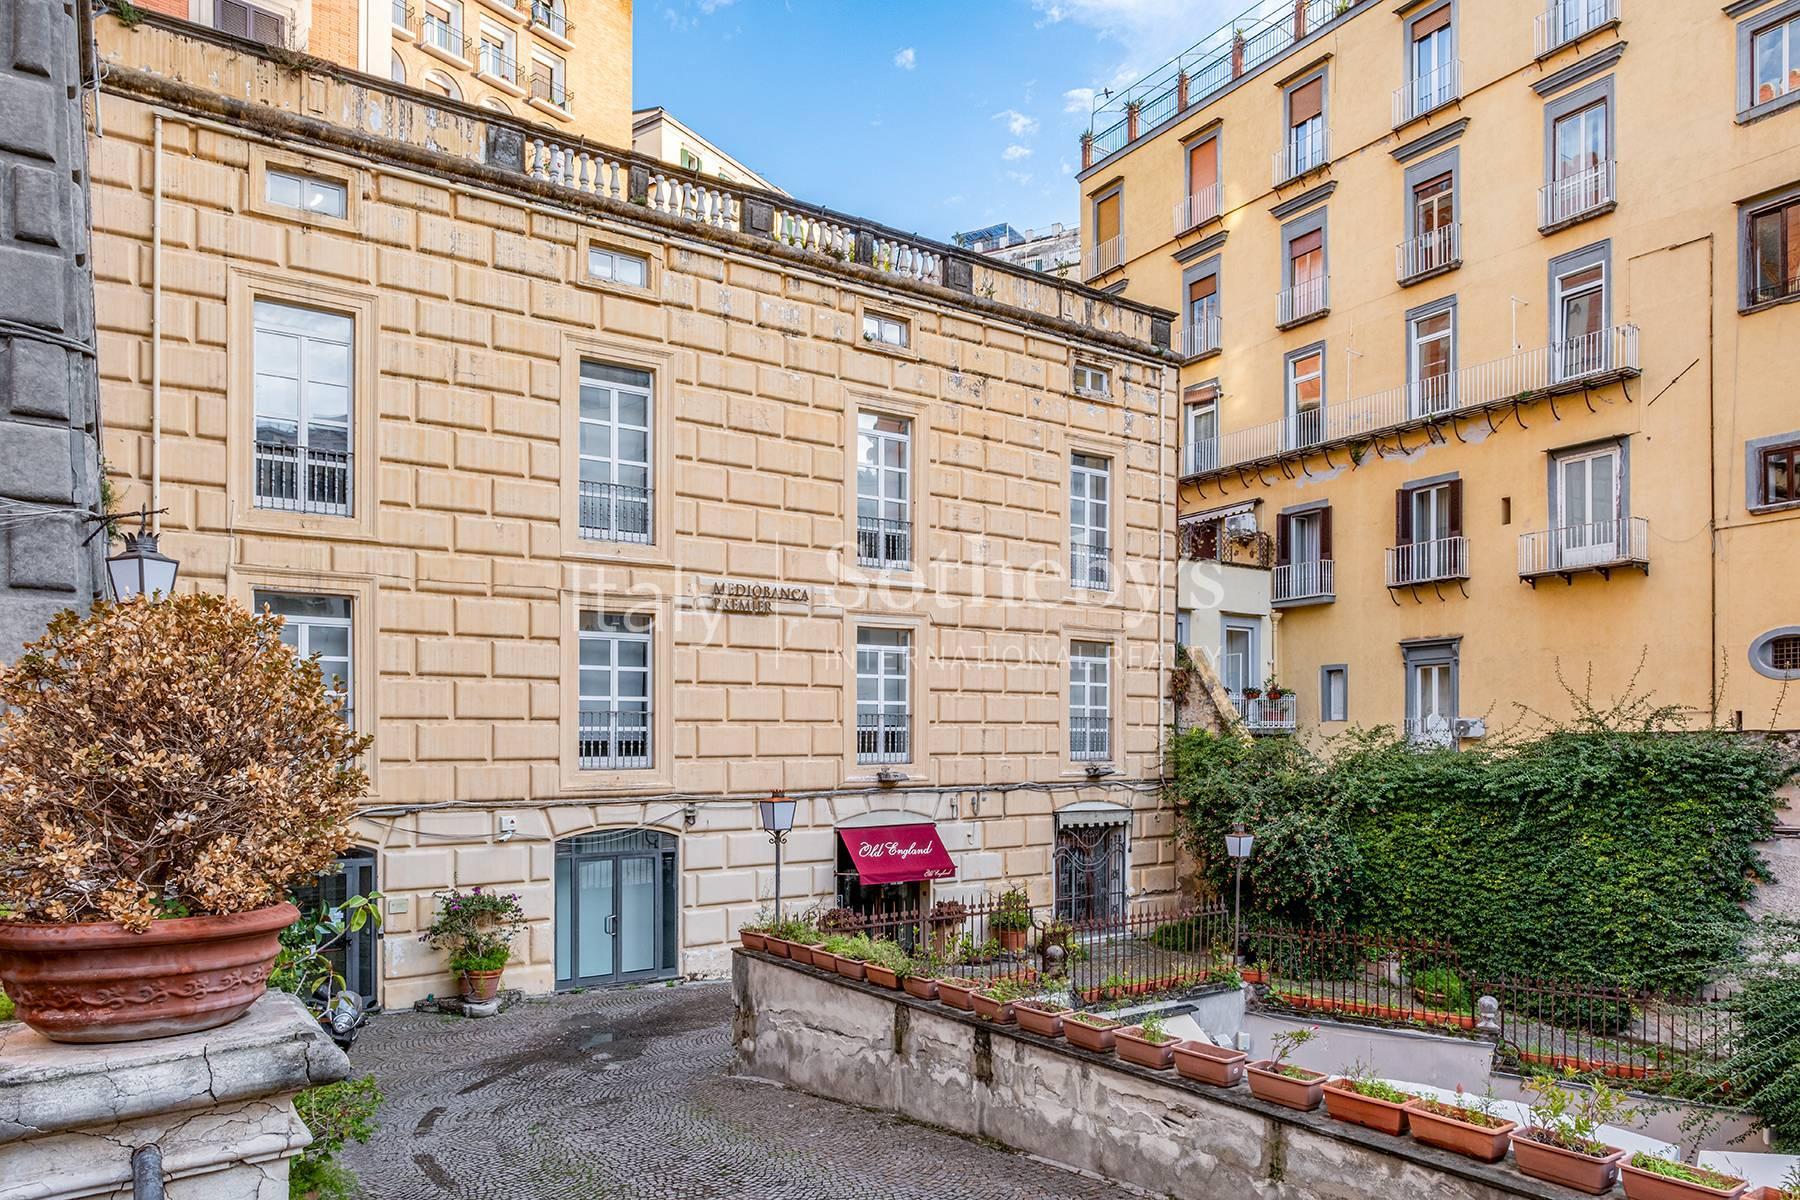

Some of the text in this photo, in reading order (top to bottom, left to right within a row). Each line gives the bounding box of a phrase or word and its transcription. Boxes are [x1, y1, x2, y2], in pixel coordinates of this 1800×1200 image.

[712, 582, 809, 601] MEDIOBANCA
[712, 598, 773, 615] PREMIER
[858, 840, 932, 859] Old England
